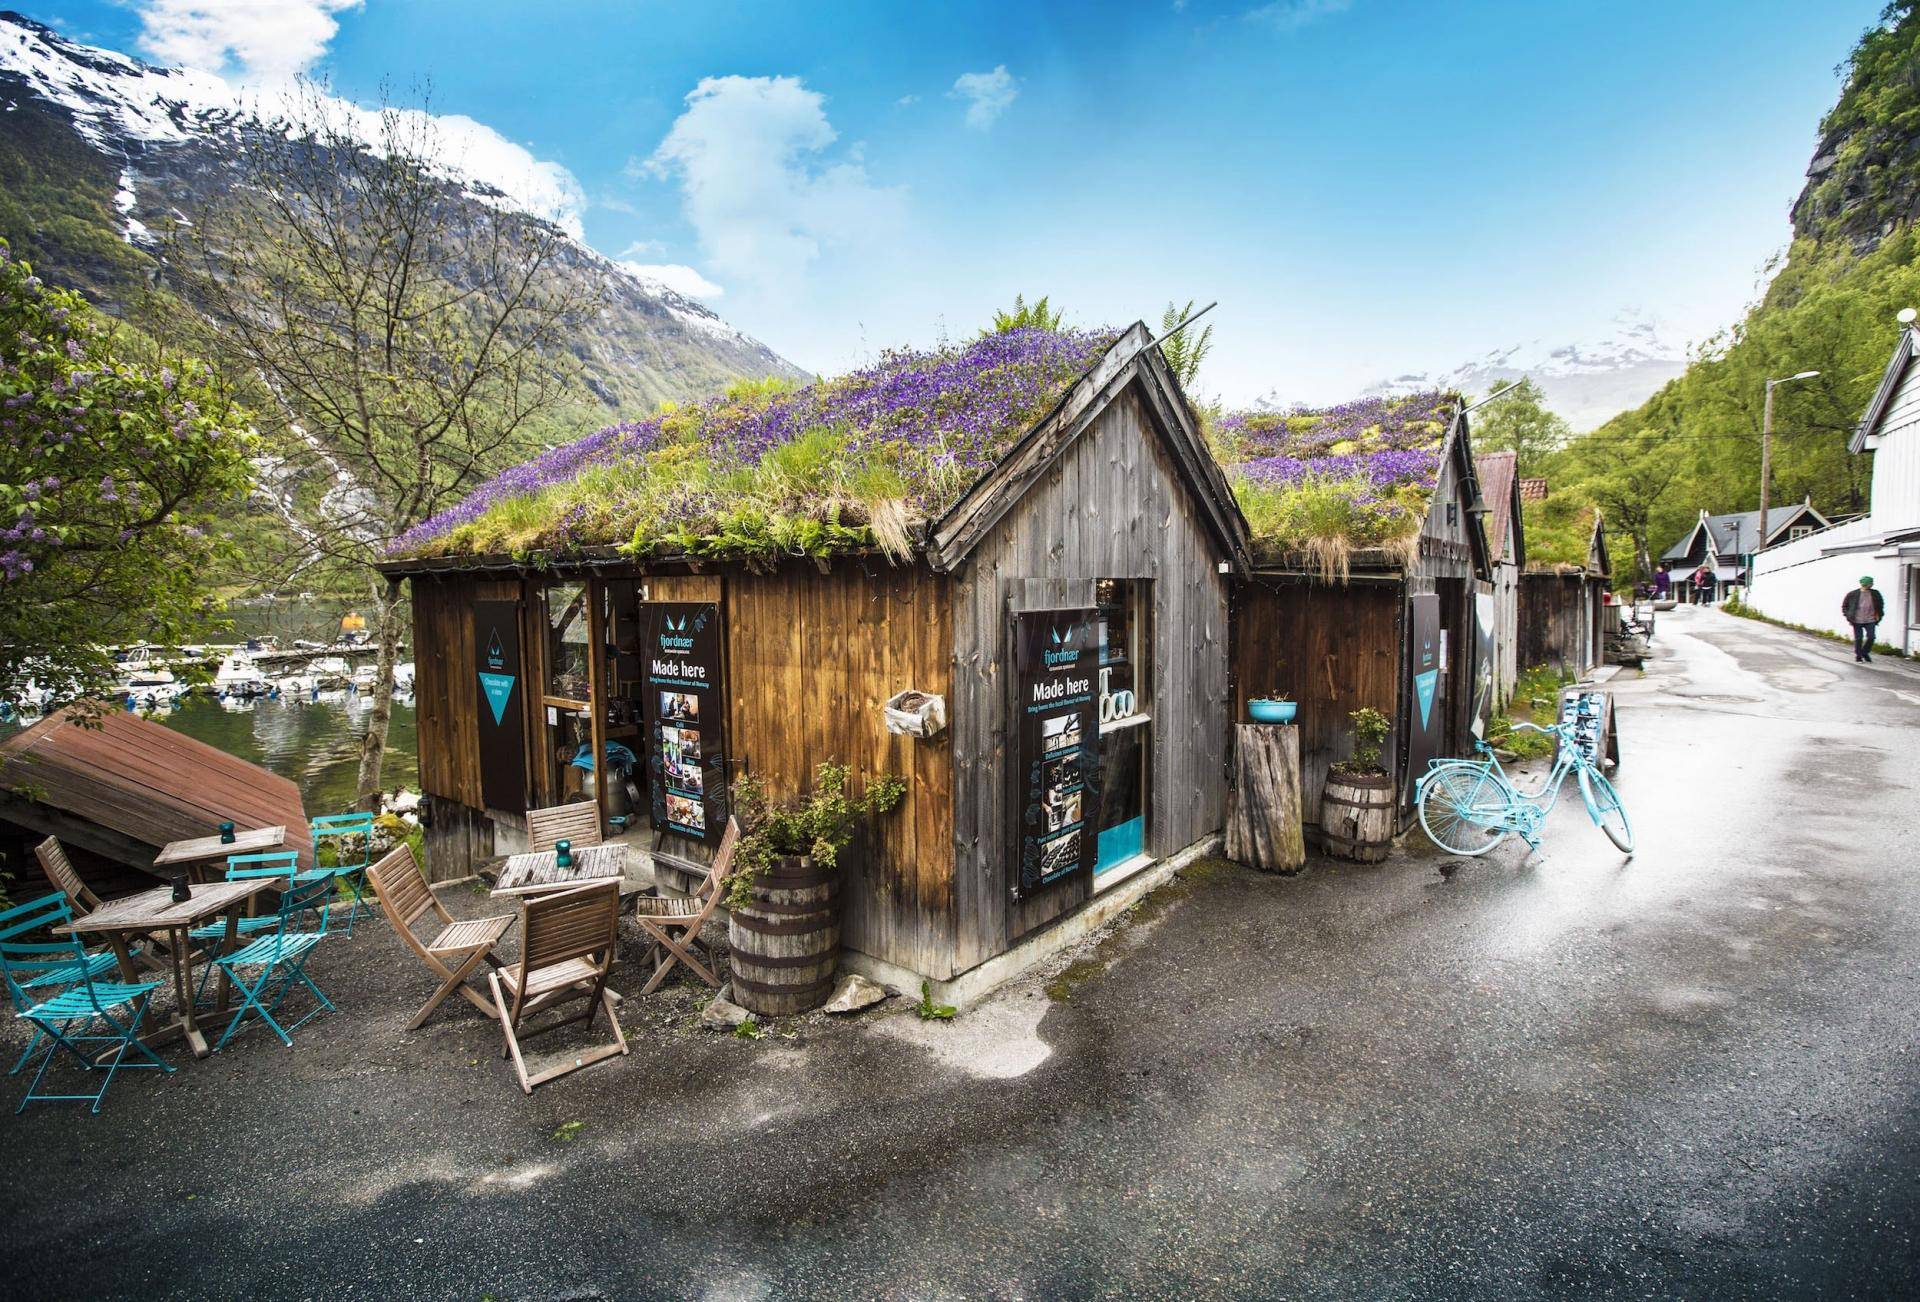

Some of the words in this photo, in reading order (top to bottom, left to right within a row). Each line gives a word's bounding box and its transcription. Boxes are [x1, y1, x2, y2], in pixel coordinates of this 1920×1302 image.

[660, 634, 694, 650] fjordnær
[1044, 646, 1080, 668] fjordnær
[652, 659, 679, 677] Made
[681, 660, 706, 679] here
[1033, 678, 1064, 702] Made
[1066, 676, 1089, 695] here
[1079, 695, 1092, 703] Norway
